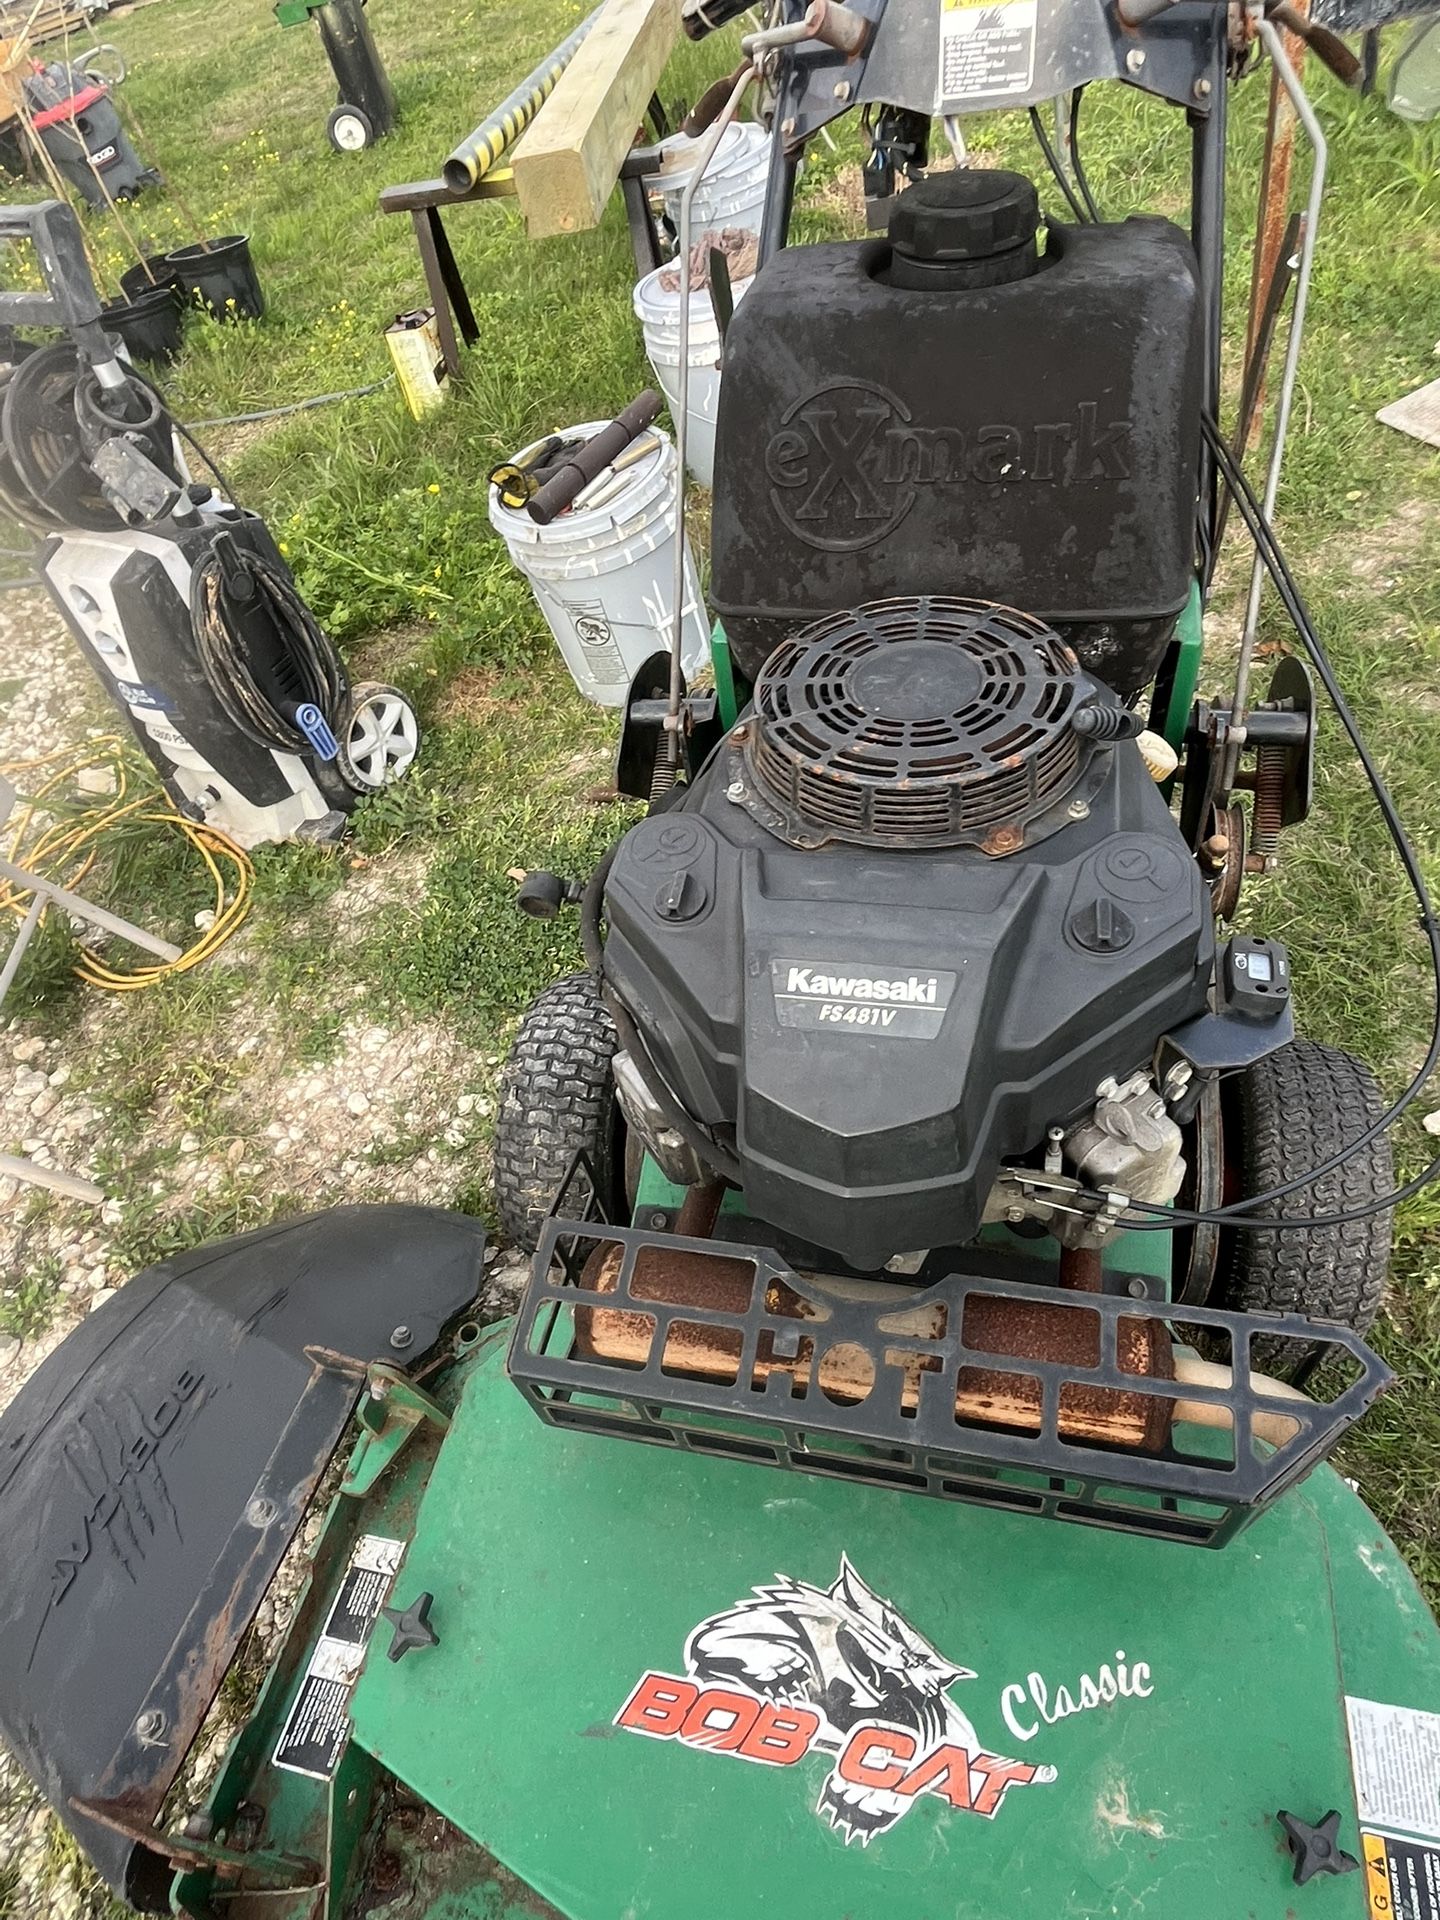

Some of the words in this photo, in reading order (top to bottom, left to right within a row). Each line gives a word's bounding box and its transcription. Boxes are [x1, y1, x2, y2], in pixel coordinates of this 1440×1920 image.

[786, 967, 938, 1004] Kawasaki
[818, 1004, 897, 1027] FS481V
[750, 1328, 944, 1420] HOT
[1001, 1649, 1155, 1742] Classic
[617, 1673, 1037, 1816] BOB-CAT
[1389, 1857, 1397, 1872] OR
[1406, 1857, 1416, 1887] AFTER
[1391, 1872, 1401, 1903] COVER
